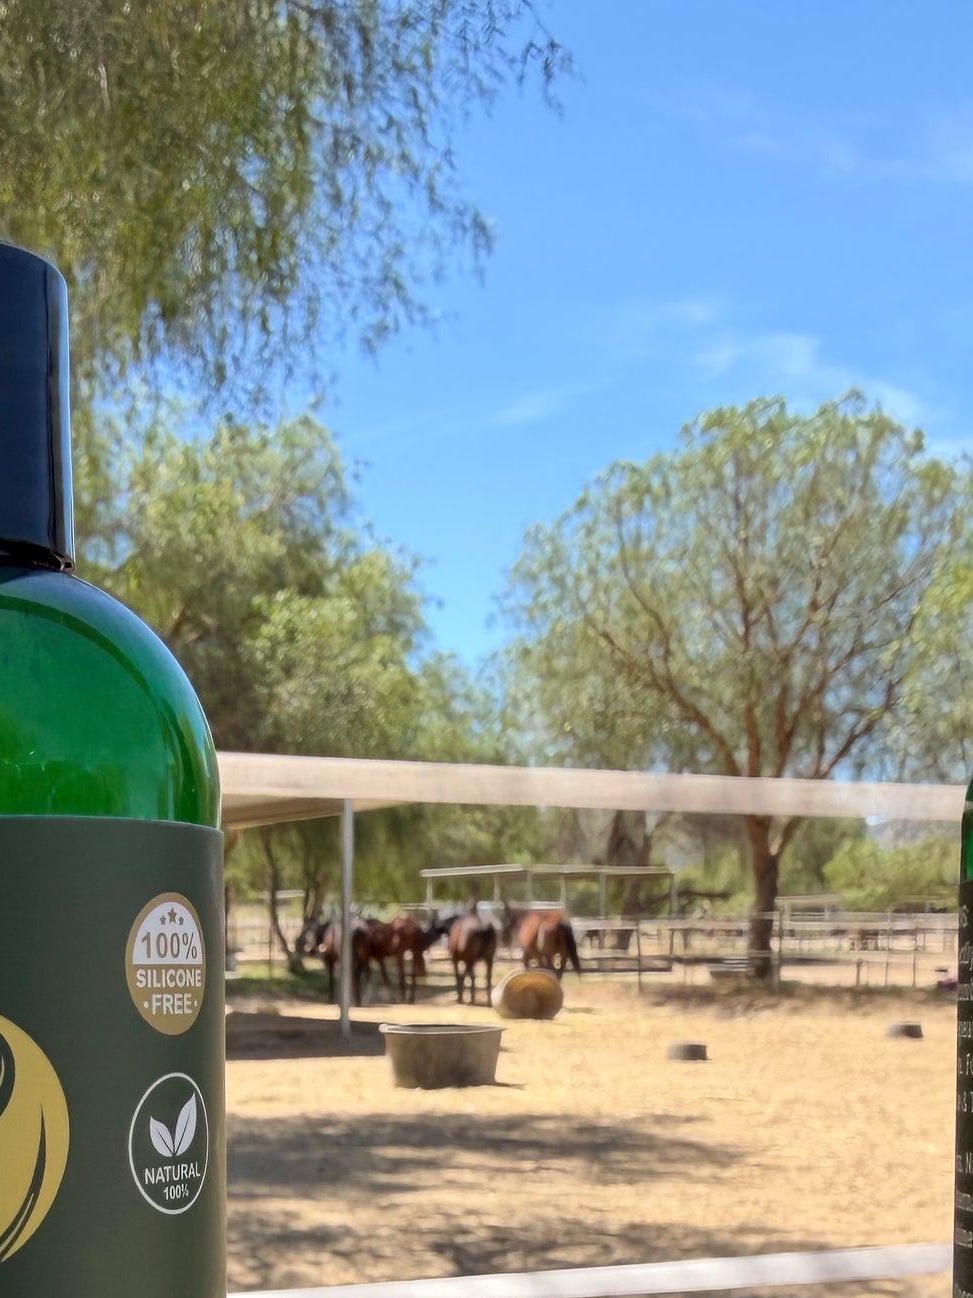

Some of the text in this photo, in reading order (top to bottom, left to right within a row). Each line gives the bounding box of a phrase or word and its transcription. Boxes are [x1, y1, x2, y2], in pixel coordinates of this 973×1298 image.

[142, 932, 197, 959] 100%
[136, 969, 201, 988] SILICONE
[145, 1162, 200, 1185] NATURAL
[163, 1185, 189, 1201] 100%
